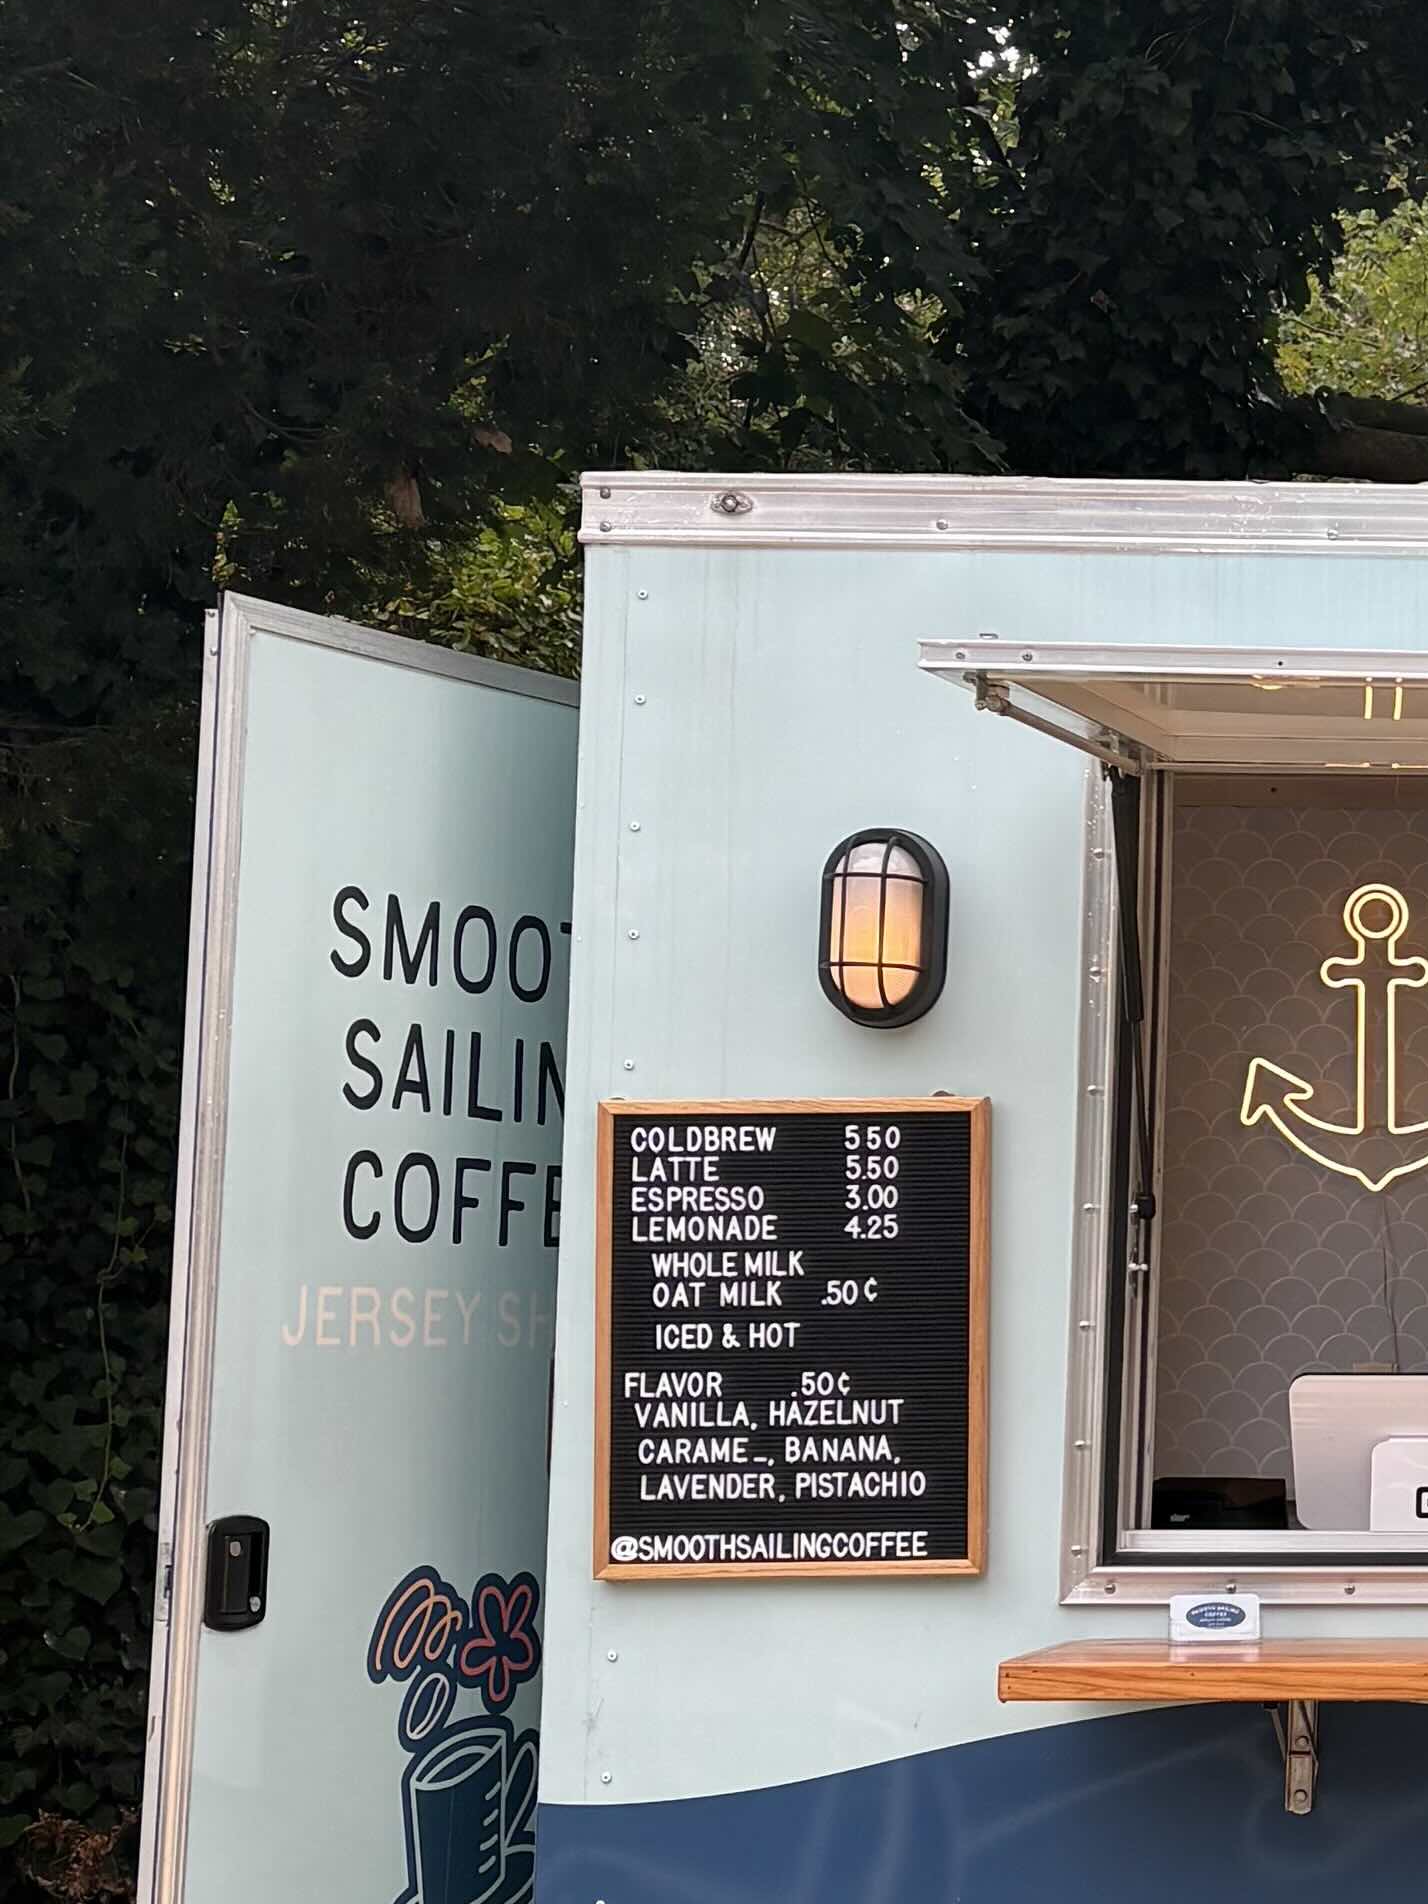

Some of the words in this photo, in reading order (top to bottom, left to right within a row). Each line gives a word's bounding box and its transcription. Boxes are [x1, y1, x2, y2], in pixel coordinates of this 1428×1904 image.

[331, 886, 572, 1002] SMOO
[343, 1019, 564, 1124] SAILIN
[631, 1126, 776, 1153] COLDBREW
[632, 1156, 719, 1182] LATTE
[846, 1155, 898, 1179] 5.50
[632, 1186, 764, 1212] ESPRESSO
[845, 1185, 898, 1210] 3.00
[633, 1215, 777, 1242] LEMONADE
[844, 1214, 898, 1239] 4.25
[652, 1252, 738, 1278] WHOLE
[745, 1251, 804, 1276] MILK
[653, 1282, 705, 1307] OAT
[720, 1281, 781, 1306] MILK
[281, 1284, 481, 1346] JERSEY
[656, 1324, 712, 1349] ICED
[722, 1324, 740, 1348] &
[750, 1322, 800, 1348] HOT
[625, 1372, 722, 1398] FLAVOR
[635, 1401, 757, 1430] VANILLA,
[770, 1399, 904, 1426] HAZELNUT
[786, 1435, 900, 1464] BANANA,
[641, 1473, 785, 1502] LAVENDER,
[796, 1471, 925, 1498] PISTACHIO
[612, 1531, 928, 1560] @SMOOTHSAILINGCOFFEE
